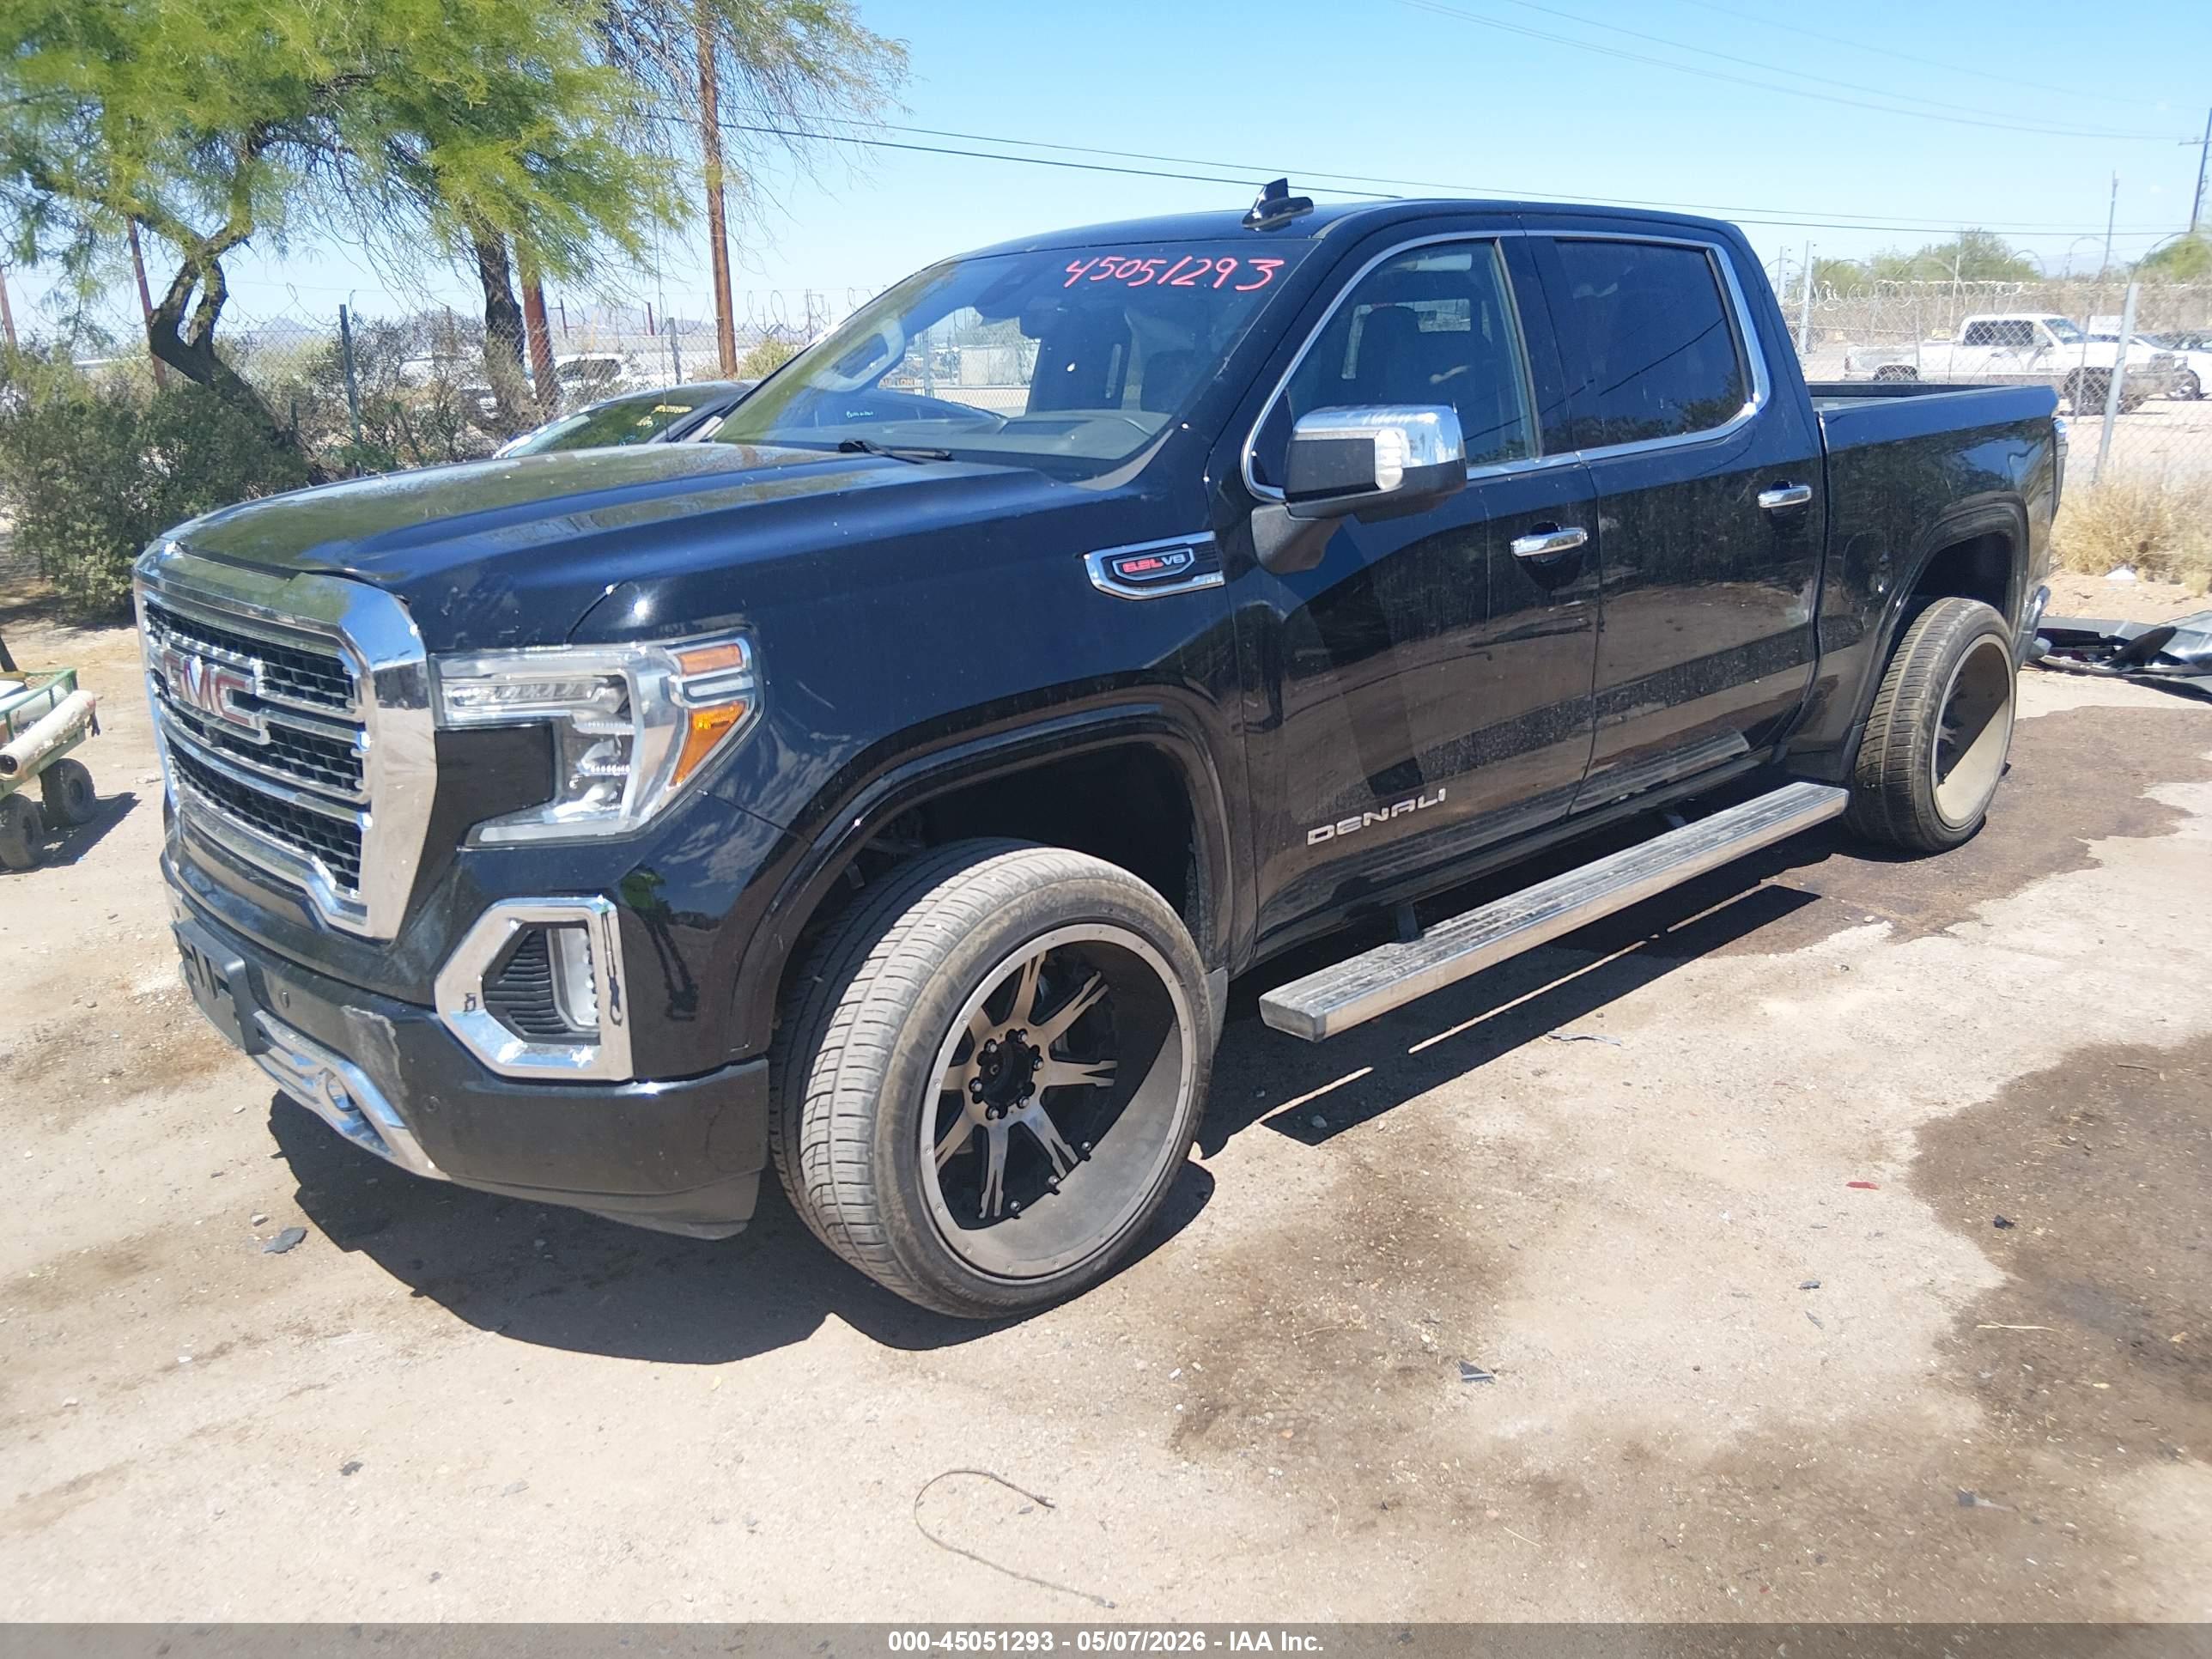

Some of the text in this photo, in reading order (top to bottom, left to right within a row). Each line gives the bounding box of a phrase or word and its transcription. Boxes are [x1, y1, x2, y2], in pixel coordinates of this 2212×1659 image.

[1064, 255, 1285, 291] 45051293
[163, 648, 257, 730] GMC
[1307, 787, 1446, 846] DENALI
